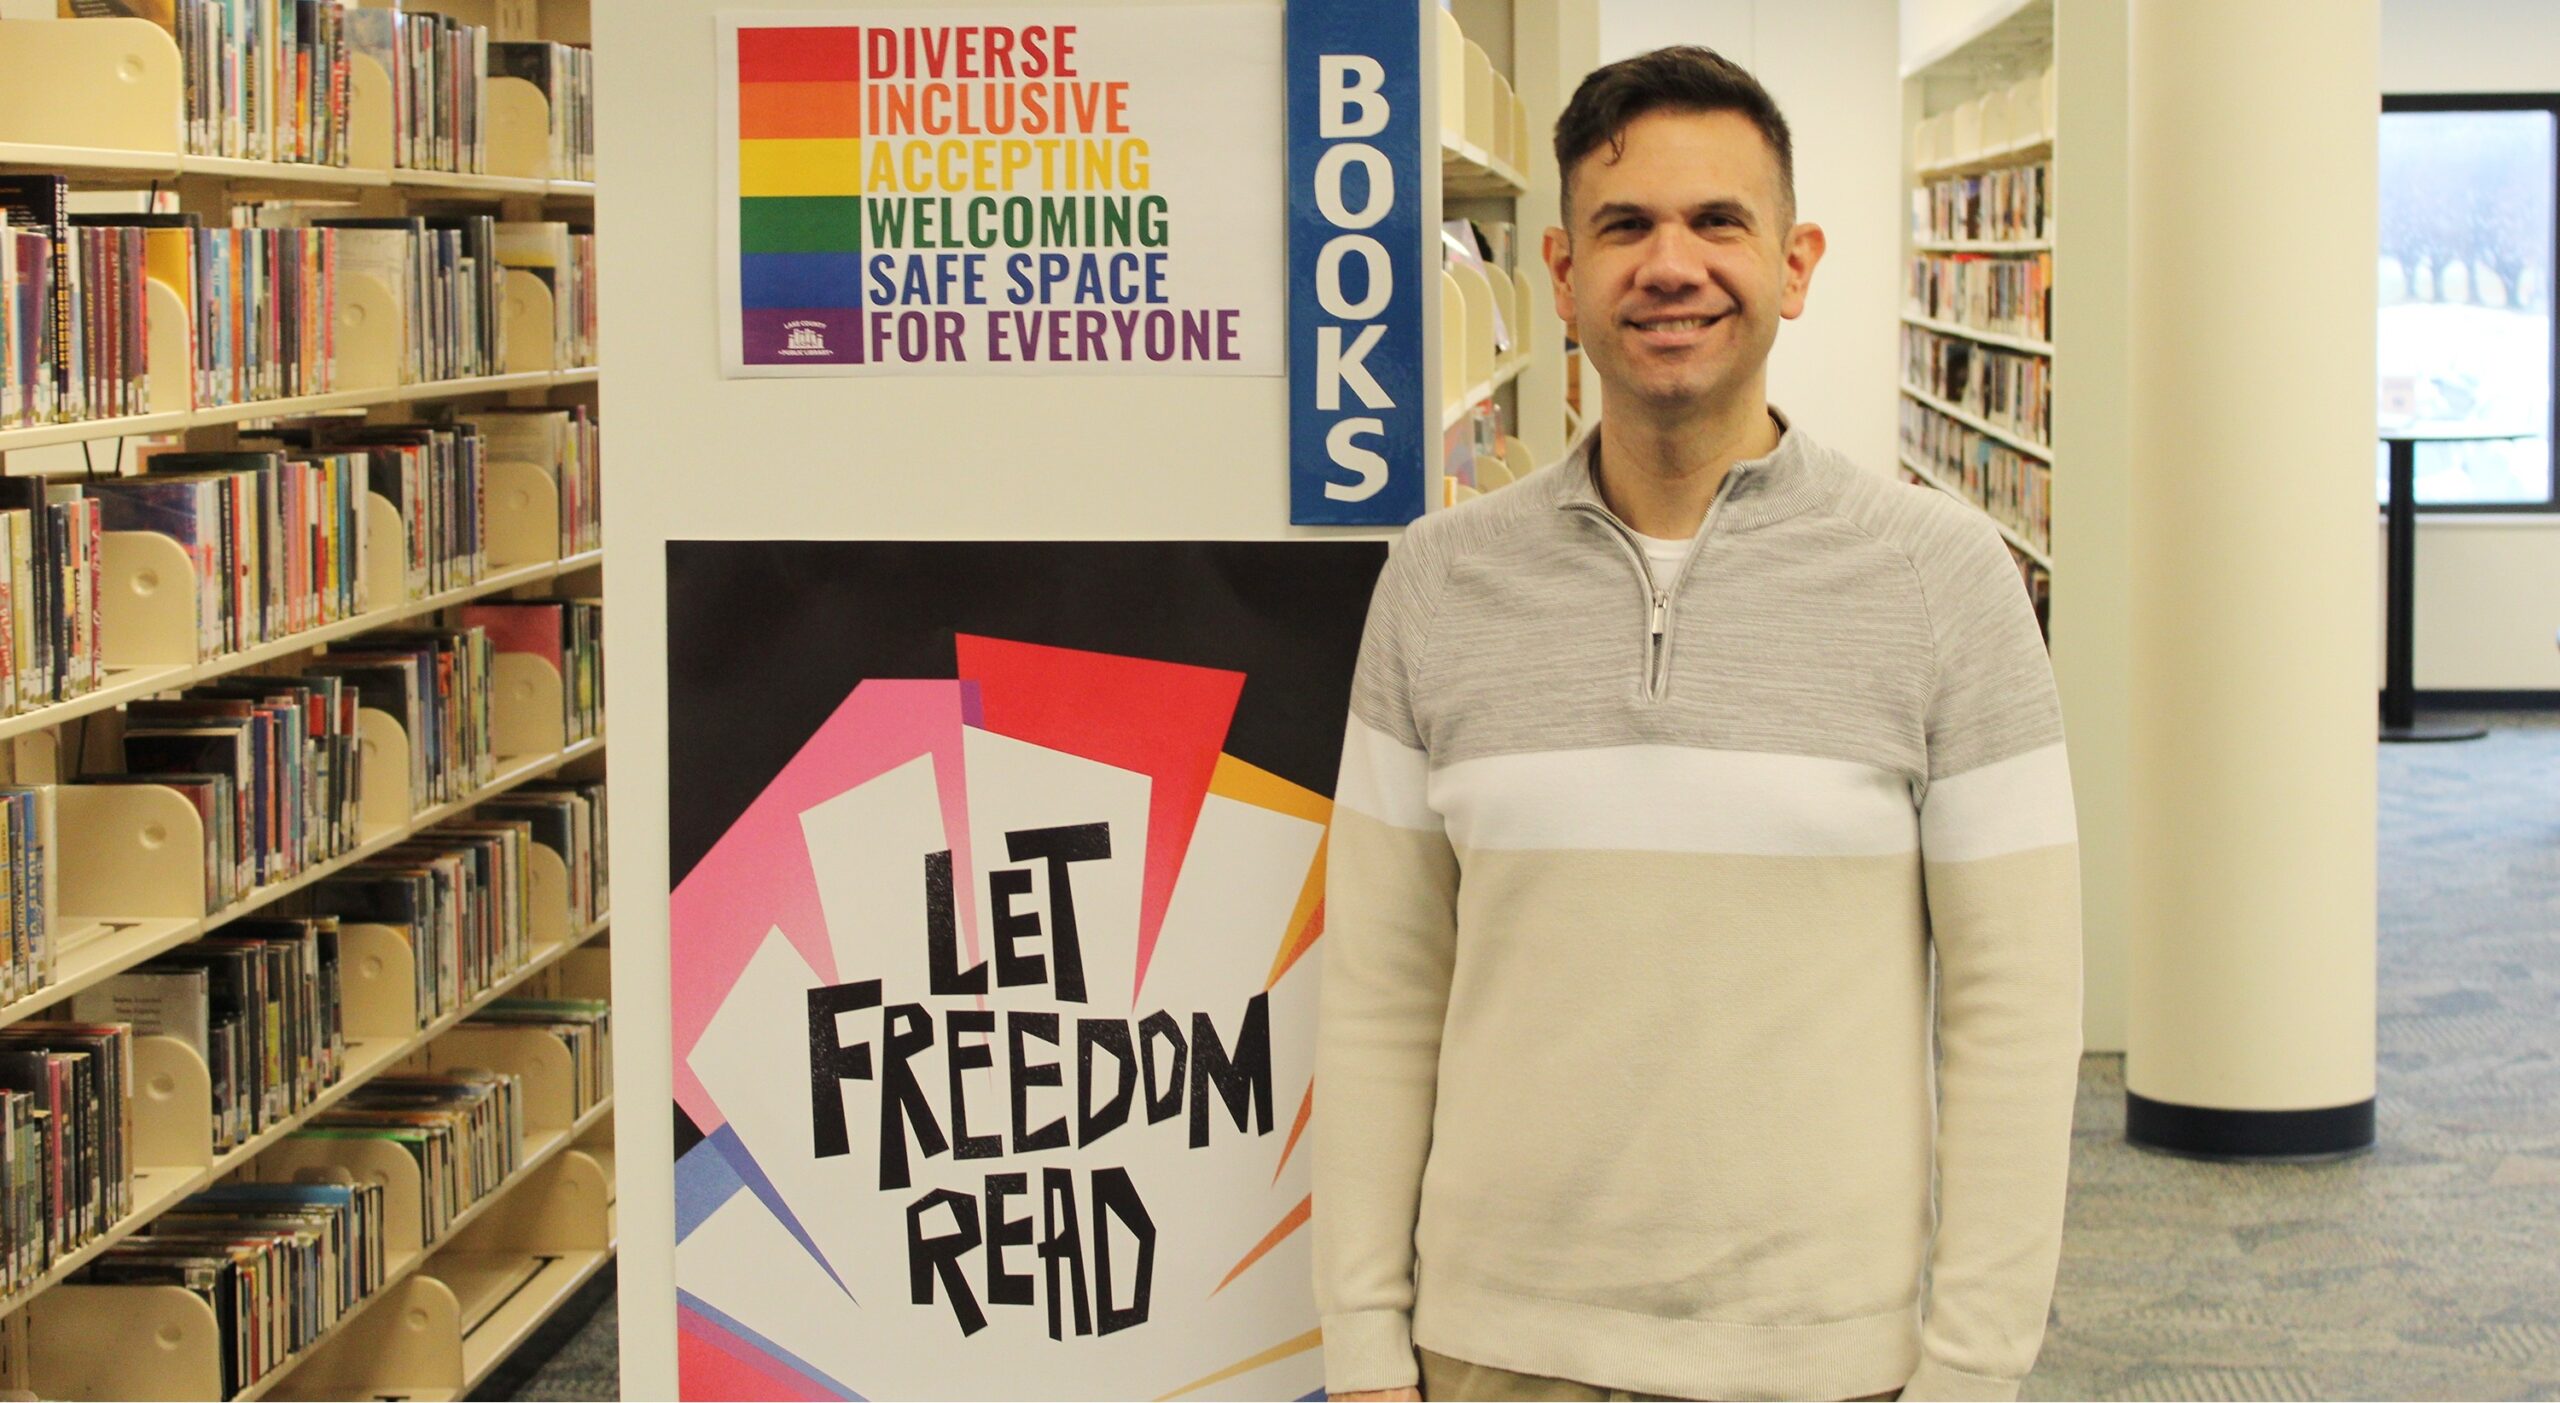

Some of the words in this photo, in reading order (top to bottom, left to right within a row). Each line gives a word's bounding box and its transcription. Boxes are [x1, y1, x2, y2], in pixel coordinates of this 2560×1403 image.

[867, 25, 1079, 80] DIVERSE
[867, 80, 1132, 136] INCLUSIVE
[867, 137, 1152, 194] ACCEPTING
[867, 194, 1170, 250] WELCOMING
[869, 253, 988, 306] SAFE
[1006, 252, 1169, 304] SPACE
[1314, 54, 1396, 502] BOOKS
[871, 310, 967, 364] FOR
[988, 309, 1242, 362] EVERYONE
[925, 822, 1112, 1004] LET
[807, 979, 1274, 1191] FREEDOM
[906, 1166, 1157, 1342] READ
